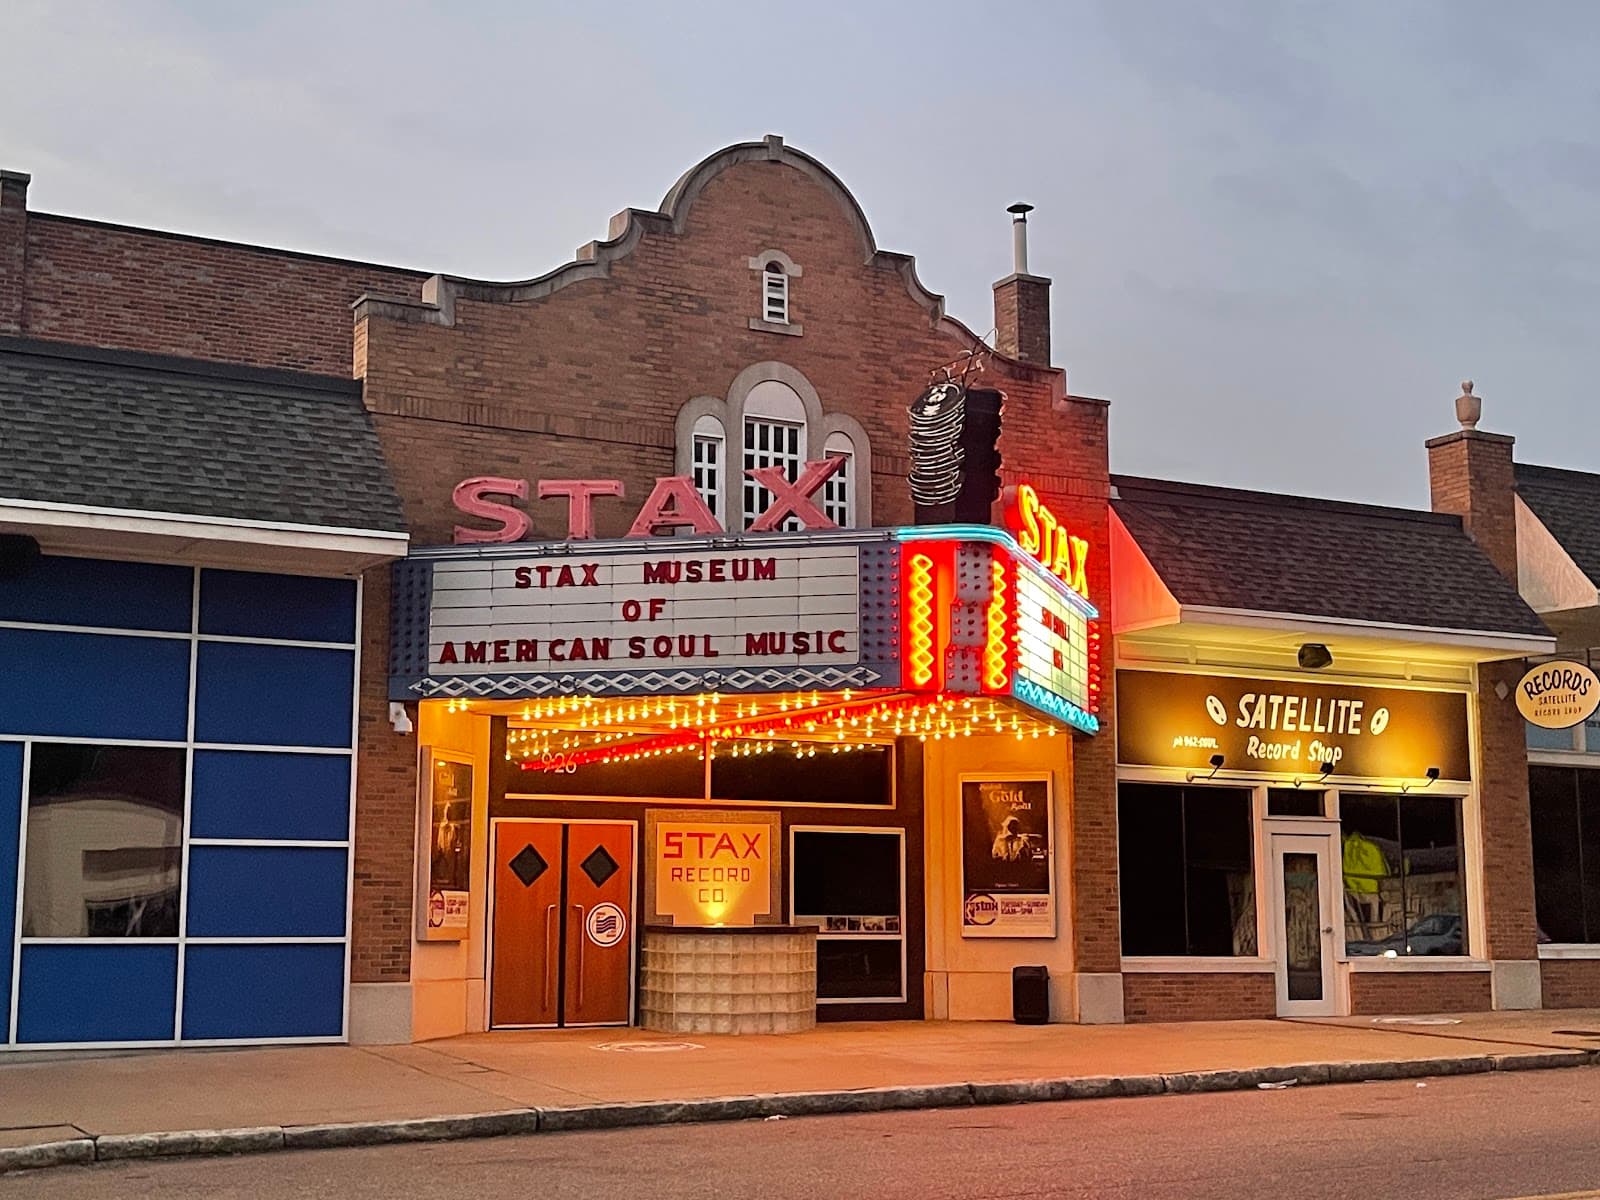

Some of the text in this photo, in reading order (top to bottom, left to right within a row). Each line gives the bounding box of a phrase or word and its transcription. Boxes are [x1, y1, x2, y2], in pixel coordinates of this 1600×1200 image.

[453, 456, 847, 545] STAX
[1018, 484, 1089, 599] STAX
[515, 558, 776, 588] STAX MUSEUM
[622, 599, 666, 622] OF
[439, 629, 847, 664] AMERICAN SOUL MUSIC
[1523, 669, 1592, 700] RECORDS
[1236, 693, 1364, 735] SATELLITE
[1538, 694, 1577, 706] SATELLITE
[541, 752, 577, 774] 926
[1247, 735, 1343, 766] Record Shop
[663, 832, 761, 859] STAX
[671, 867, 750, 883] RECORD
[698, 888, 728, 903] CO.
